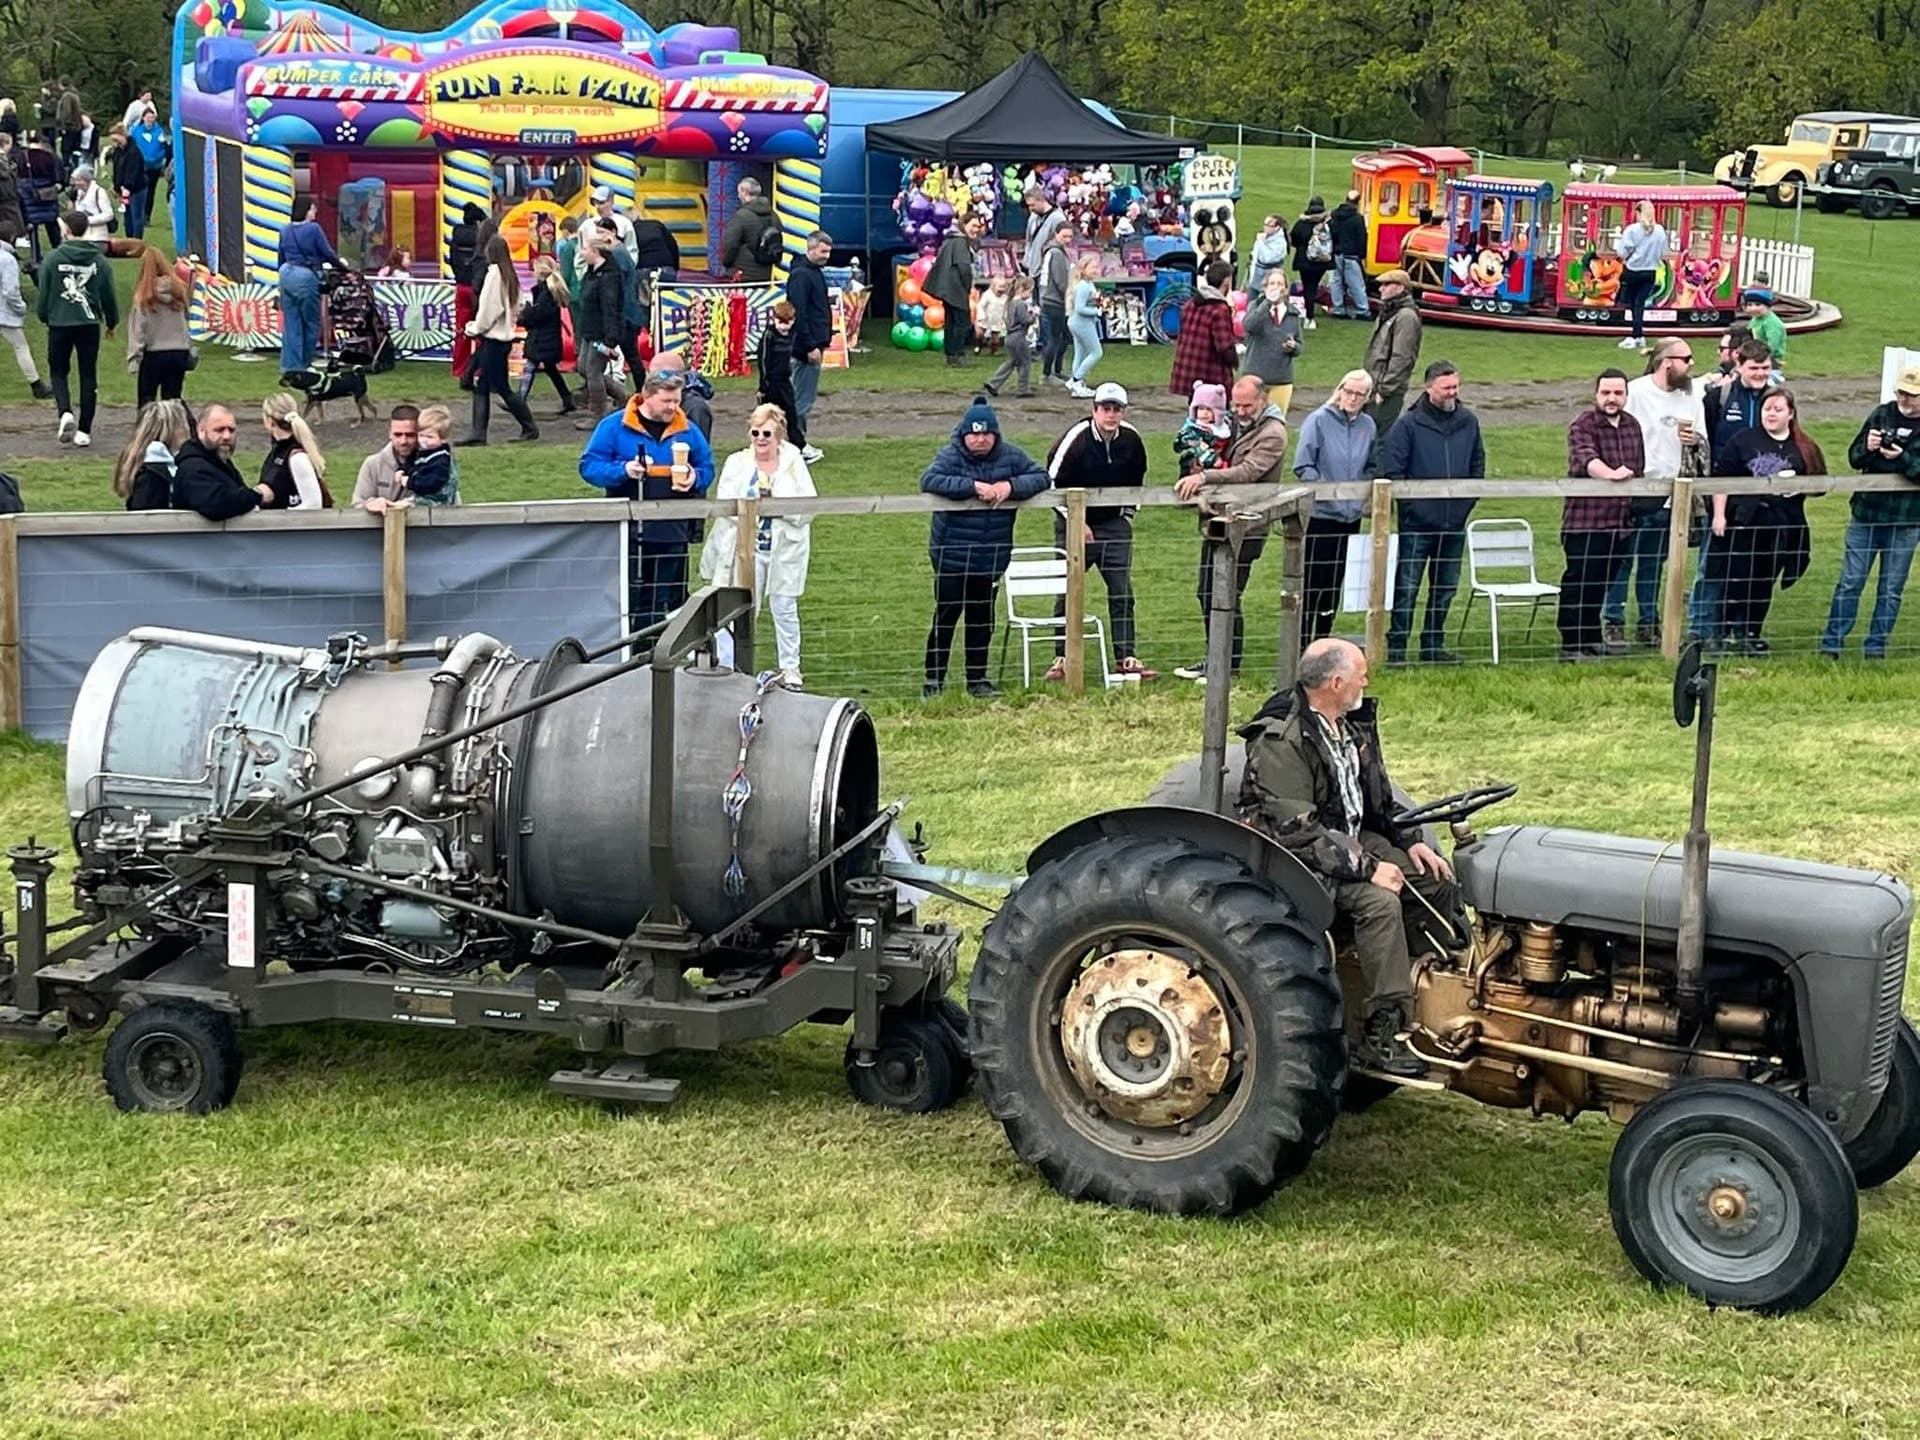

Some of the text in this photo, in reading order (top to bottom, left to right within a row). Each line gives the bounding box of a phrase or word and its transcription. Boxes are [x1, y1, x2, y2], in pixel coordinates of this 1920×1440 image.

[266, 67, 396, 85] BUMPER CARS
[432, 74, 501, 101] FUN
[509, 70, 572, 96] FAIR
[578, 73, 661, 108] PARK
[531, 103, 564, 117] place
[584, 105, 616, 117] earth
[521, 131, 573, 144] ENTER
[1193, 159, 1232, 169] PRIZE
[1192, 168, 1234, 179] EVERY
[1191, 181, 1230, 191] TIME
